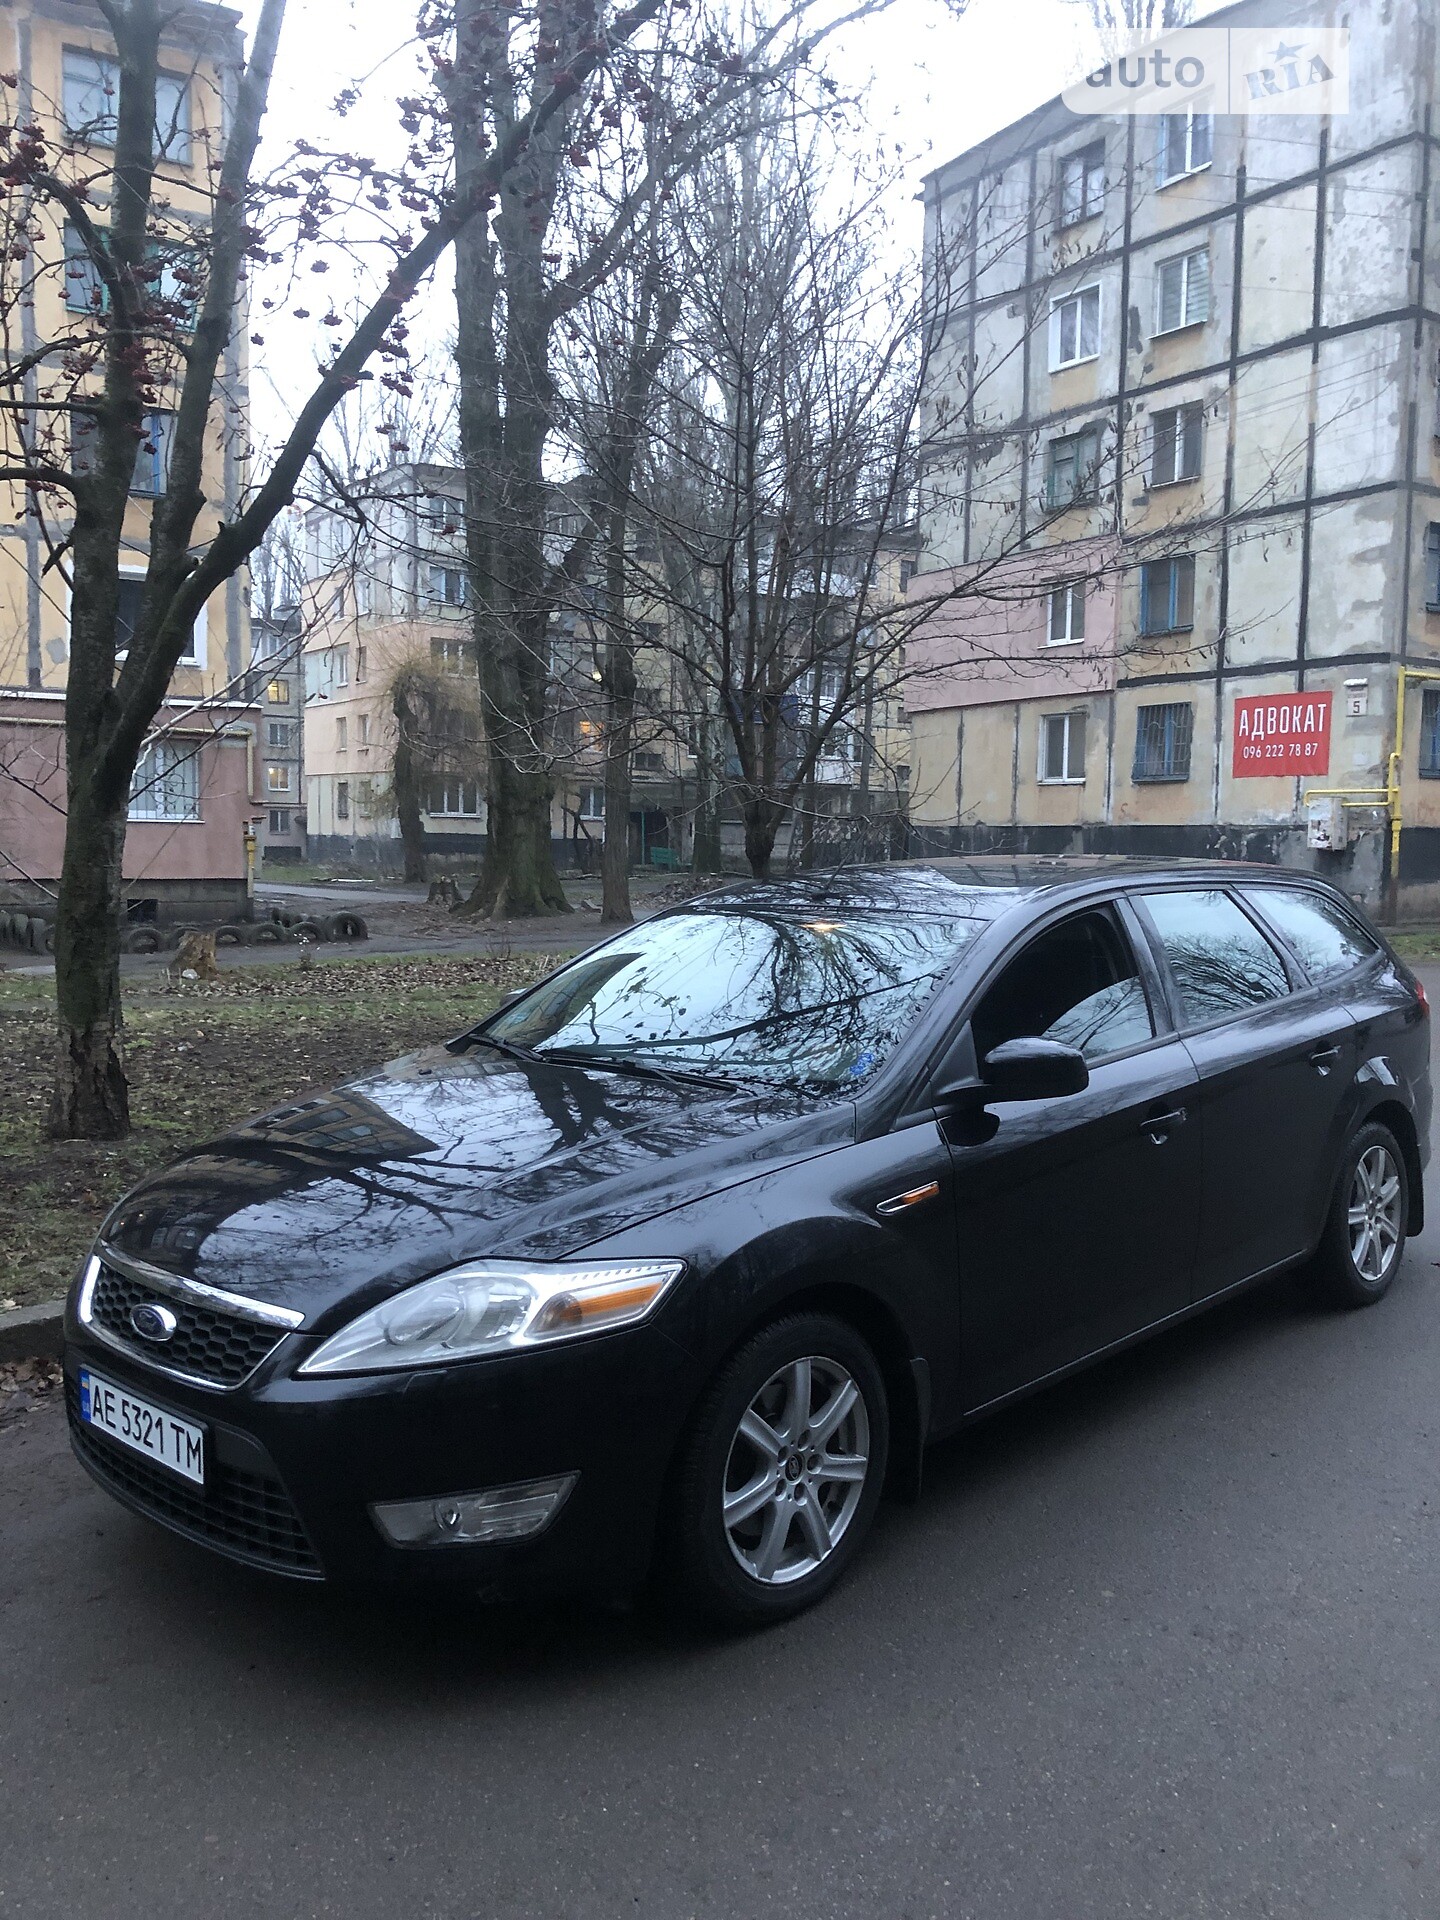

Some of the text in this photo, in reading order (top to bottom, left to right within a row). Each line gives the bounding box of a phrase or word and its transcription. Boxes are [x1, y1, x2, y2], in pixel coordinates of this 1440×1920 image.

[1352, 700, 1361, 714] 5
[1238, 703, 1327, 741] АДВОКАТ
[1243, 743, 1319, 759] 096 222 78 87
[93, 1385, 202, 1475] AE 5321 TM
